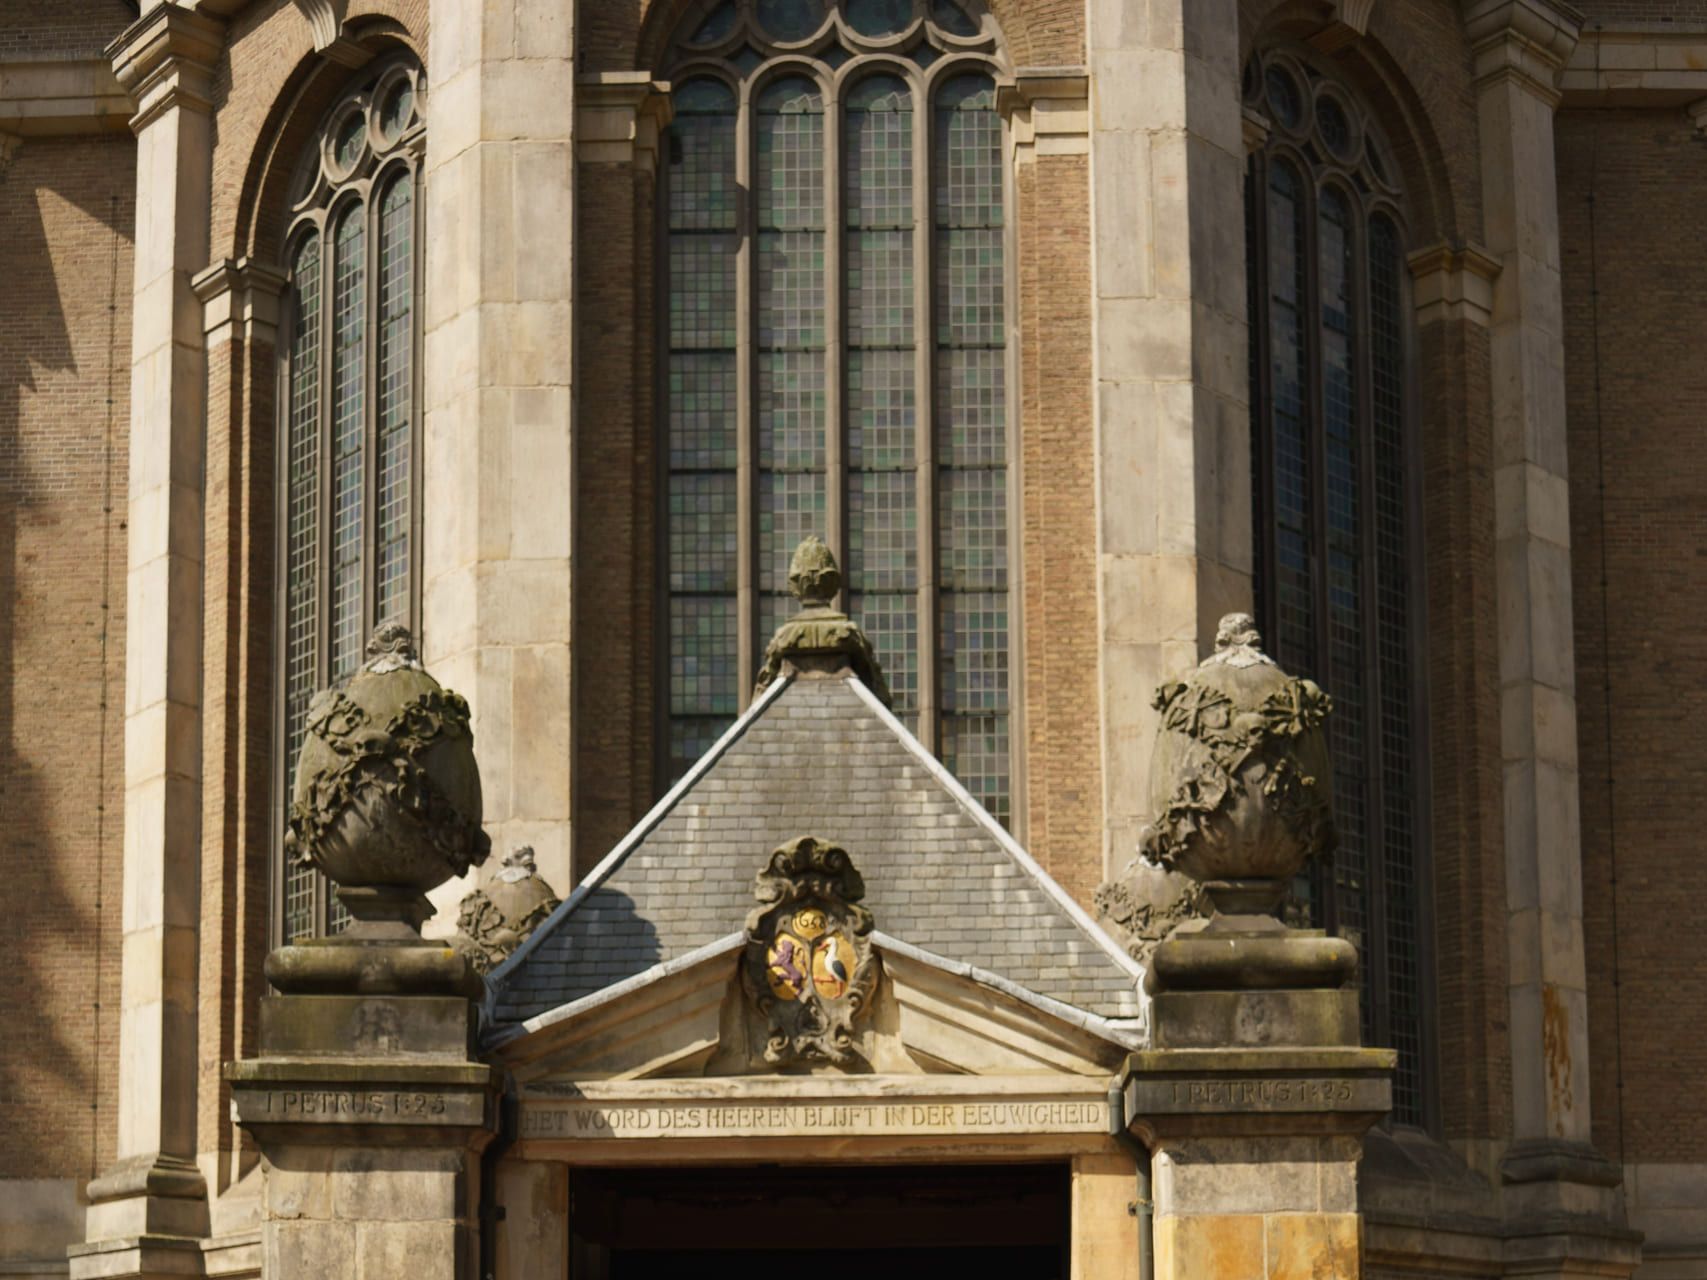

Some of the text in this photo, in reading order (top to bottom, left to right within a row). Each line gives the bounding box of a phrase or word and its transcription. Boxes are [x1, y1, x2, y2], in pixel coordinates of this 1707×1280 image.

[282, 1091, 385, 1115] PETRUS
[1188, 1081, 1292, 1104] PETRUS
[523, 1104, 1101, 1131] HET WOORD DES HEEREN BLIJFT IN DER EEUWIGHEID
